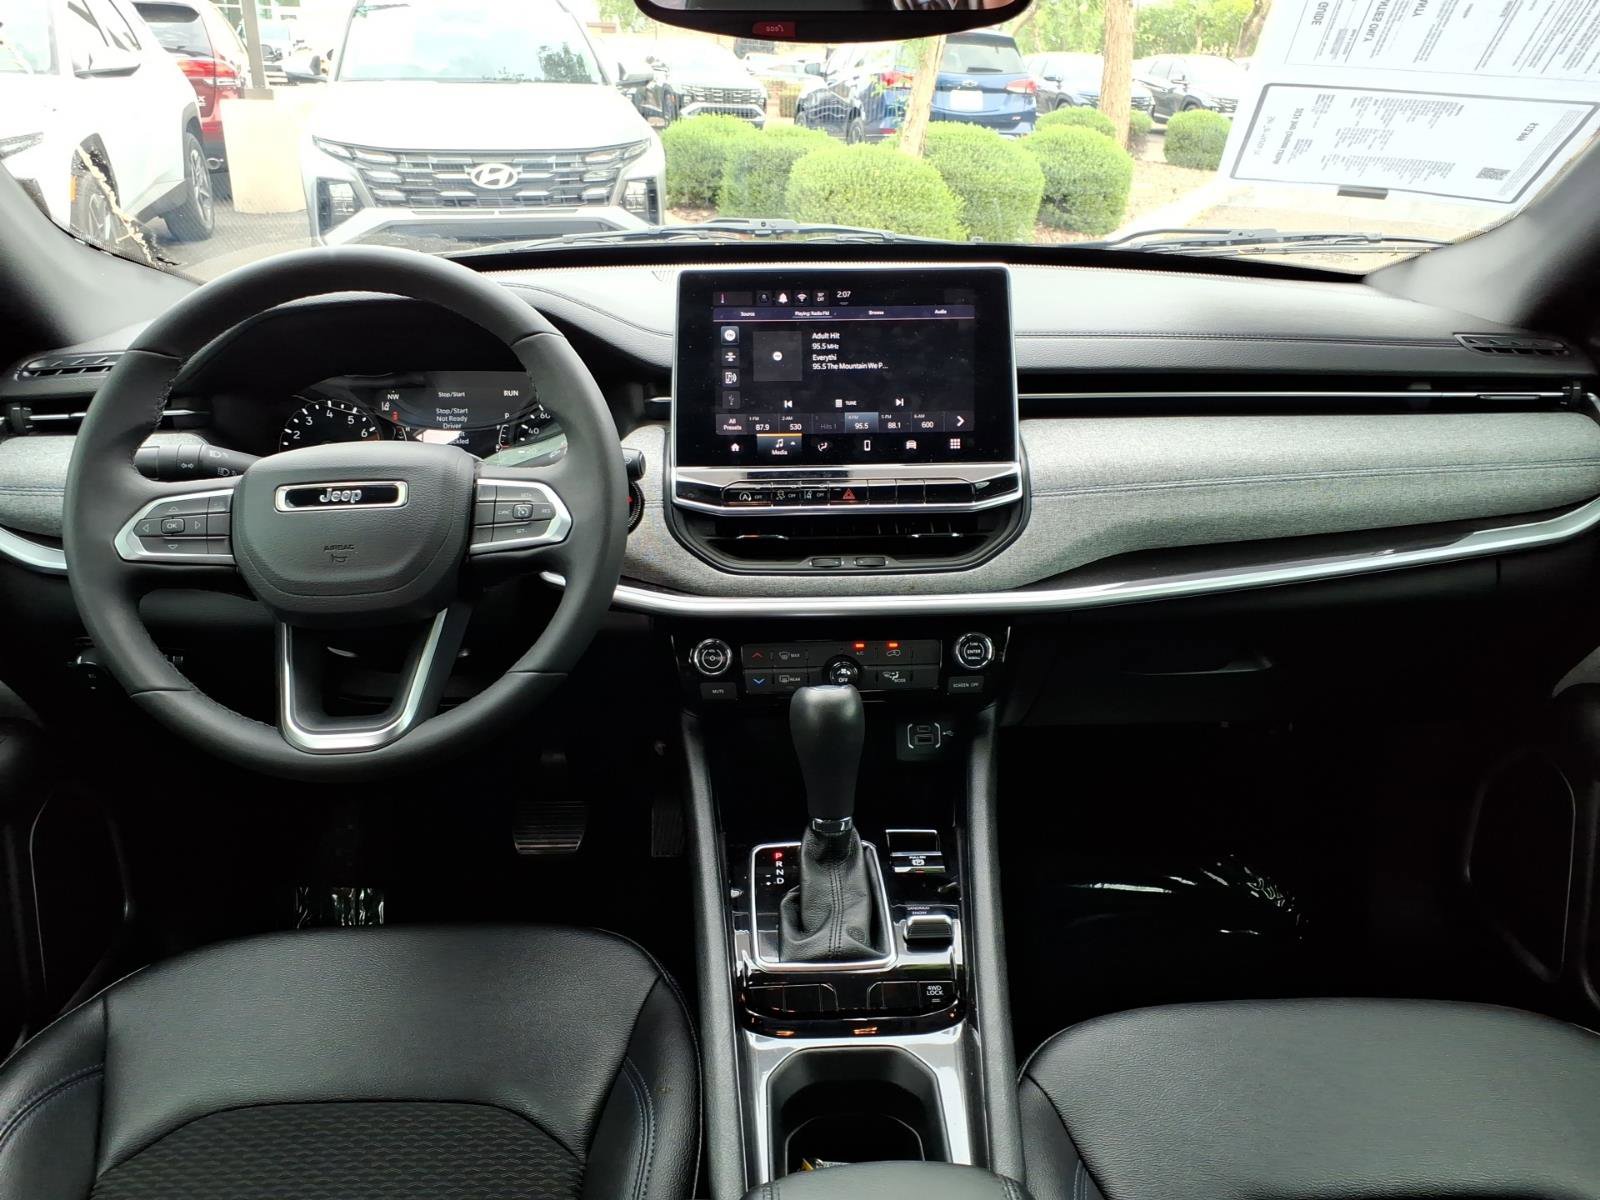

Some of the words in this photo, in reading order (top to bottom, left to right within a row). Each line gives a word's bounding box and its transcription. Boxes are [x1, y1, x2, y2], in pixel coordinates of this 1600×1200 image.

[836, 290, 851, 298] 2:07
[812, 342, 827, 350] 95.5
[812, 354, 837, 362] Everythi
[839, 362, 868, 370] Mountain
[326, 409, 334, 418] 4
[435, 407, 468, 415] Stop/Start
[305, 416, 313, 426] 3
[347, 415, 355, 425] 5
[448, 415, 468, 423] Ready
[293, 430, 301, 439] 2
[361, 428, 368, 438] 6
[319, 487, 362, 504] Jeep
[776, 877, 785, 885] D
